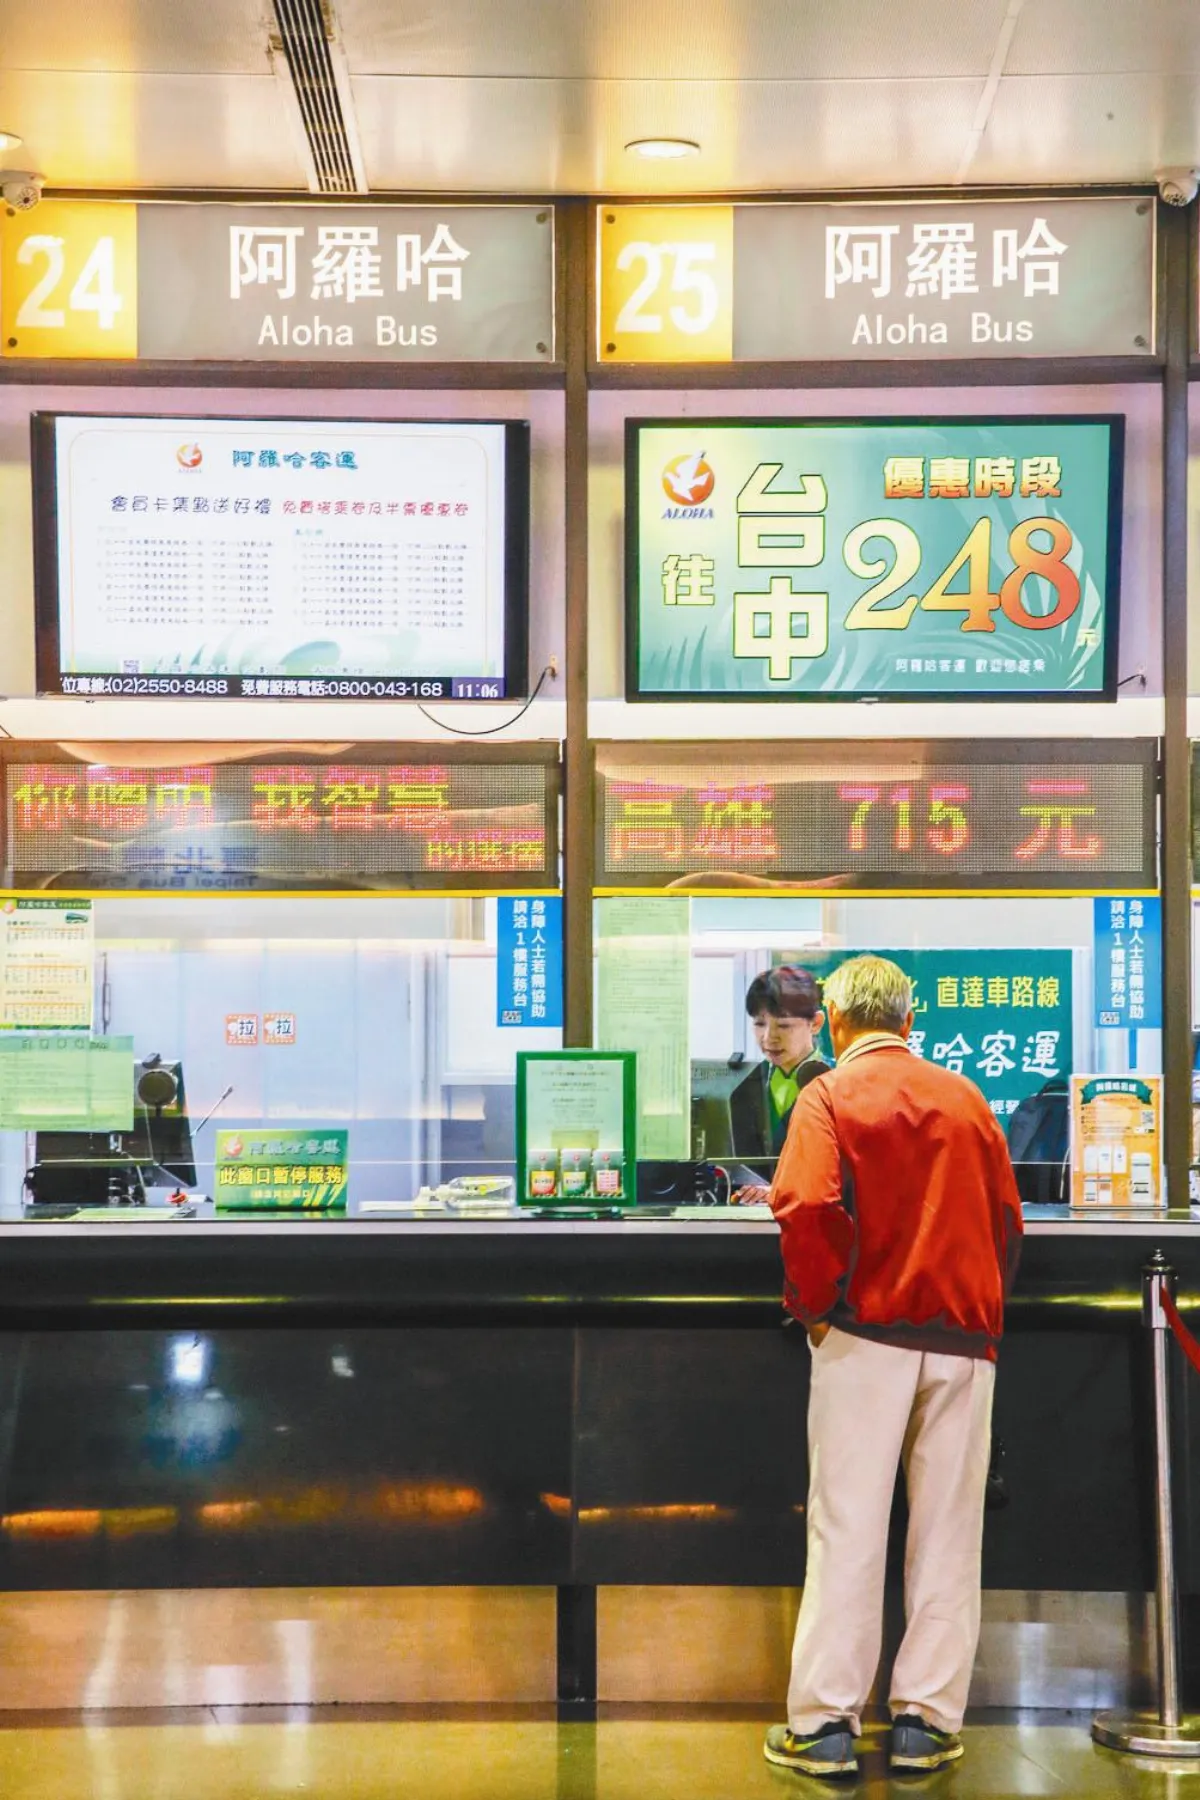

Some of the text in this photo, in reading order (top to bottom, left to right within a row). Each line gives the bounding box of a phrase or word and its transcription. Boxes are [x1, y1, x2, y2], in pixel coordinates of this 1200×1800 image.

[230, 224, 470, 303] 阿羅哈
[825, 217, 1069, 300] 阿羅哈
[15, 234, 123, 330] 24
[615, 241, 718, 334] 25
[258, 315, 438, 346] Aloha Bus
[851, 311, 1033, 345] Aloha Bus
[232, 450, 358, 470] 阿羅哈客運
[884, 457, 1062, 498] 優惠時段
[111, 495, 271, 514] 會員卡集點送好禮
[661, 507, 714, 519] ALOHA
[662, 554, 715, 606] 往
[733, 463, 829, 680] 台中
[842, 516, 1099, 646] 248 元
[457, 684, 498, 698] 11:06
[609, 779, 1101, 861] 高雄 715 元
[531, 900, 546, 1018] 身障人士若需協助
[239, 1019, 255, 1036] 拉
[276, 1018, 292, 1035] 拉
[220, 1165, 343, 1185] 此窗口暫停服務
